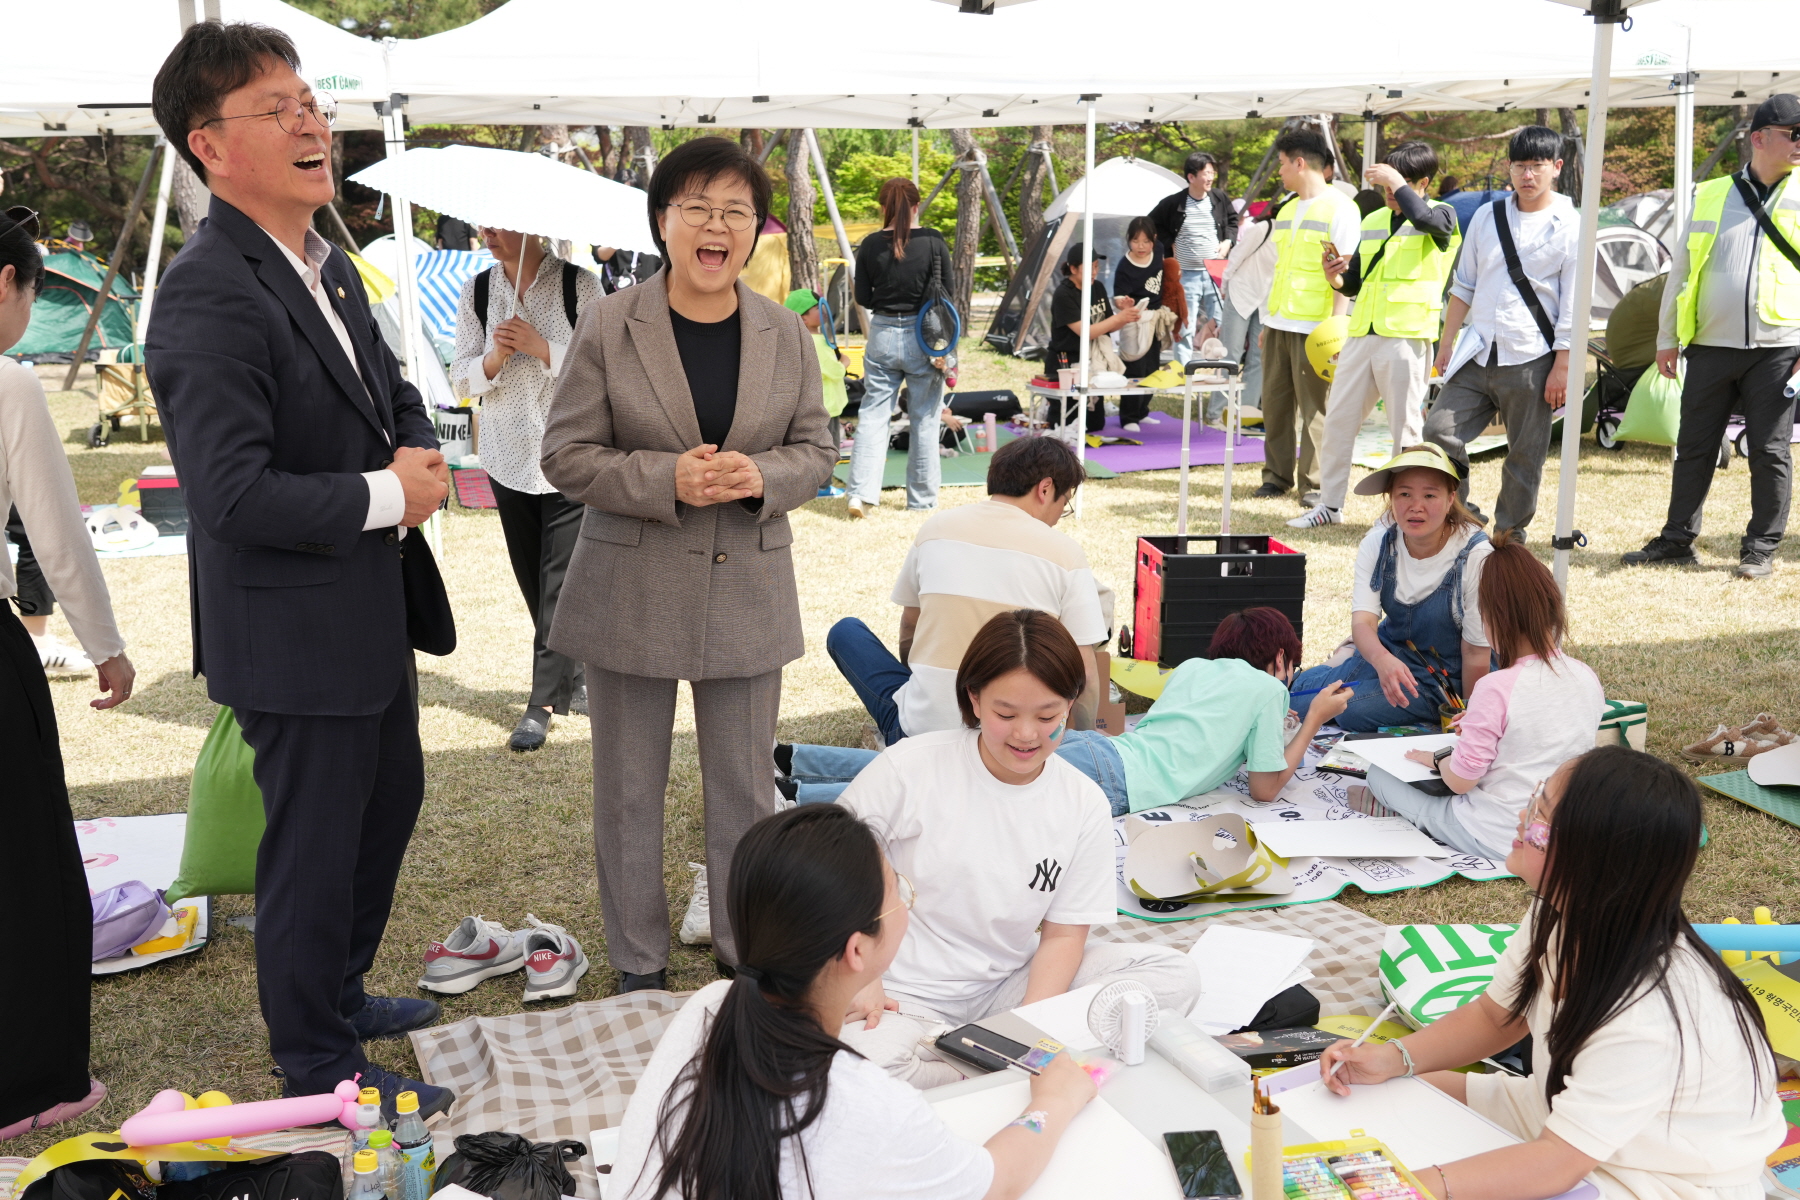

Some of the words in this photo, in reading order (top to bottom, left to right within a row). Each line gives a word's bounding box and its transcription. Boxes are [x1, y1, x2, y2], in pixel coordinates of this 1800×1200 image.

[317, 75, 338, 90] BEST
[437, 422, 467, 441] NIKE
[1723, 741, 1735, 756] B
[1028, 858, 1062, 892] NY
[533, 952, 553, 963] NIKE
